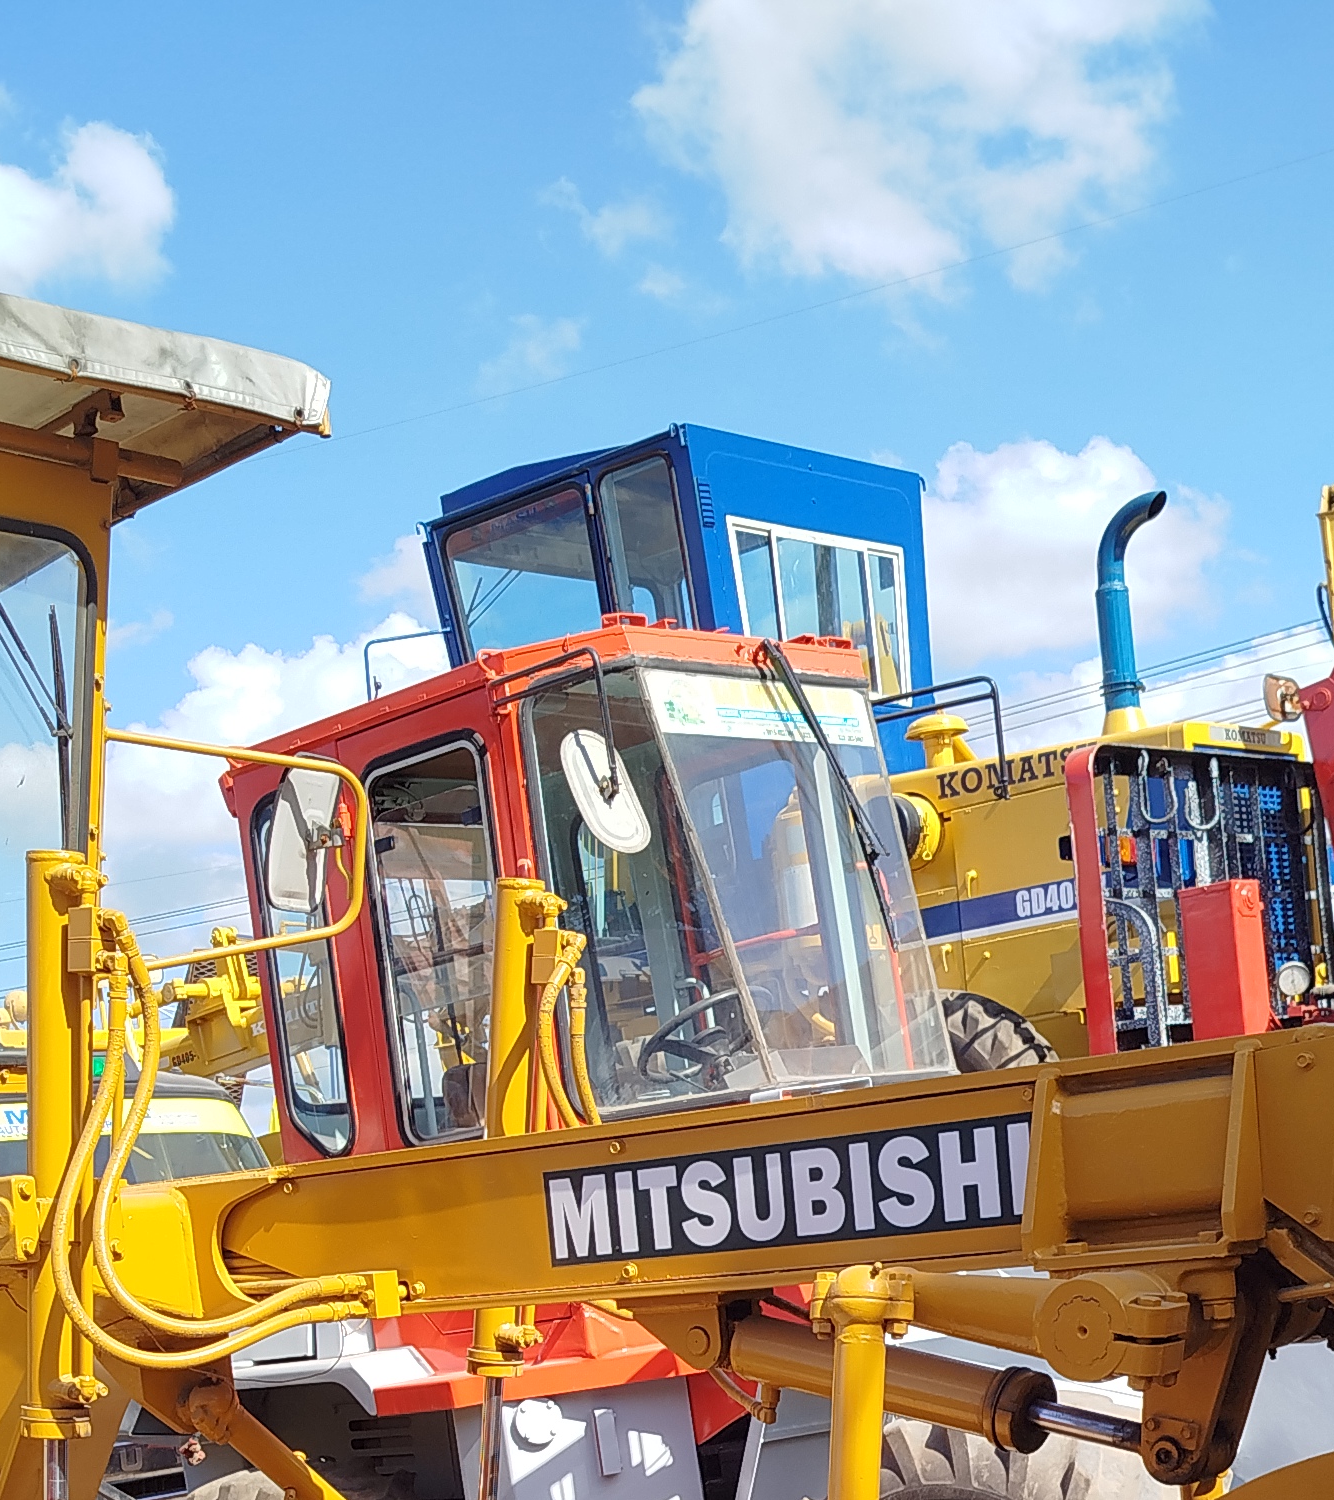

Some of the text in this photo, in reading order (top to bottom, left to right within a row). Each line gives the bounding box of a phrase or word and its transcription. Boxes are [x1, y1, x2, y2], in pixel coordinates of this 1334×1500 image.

[1224, 728, 1266, 744] KOMATSU
[1015, 880, 1078, 918] GD40
[547, 1120, 1031, 1261] MITSUBISHI
